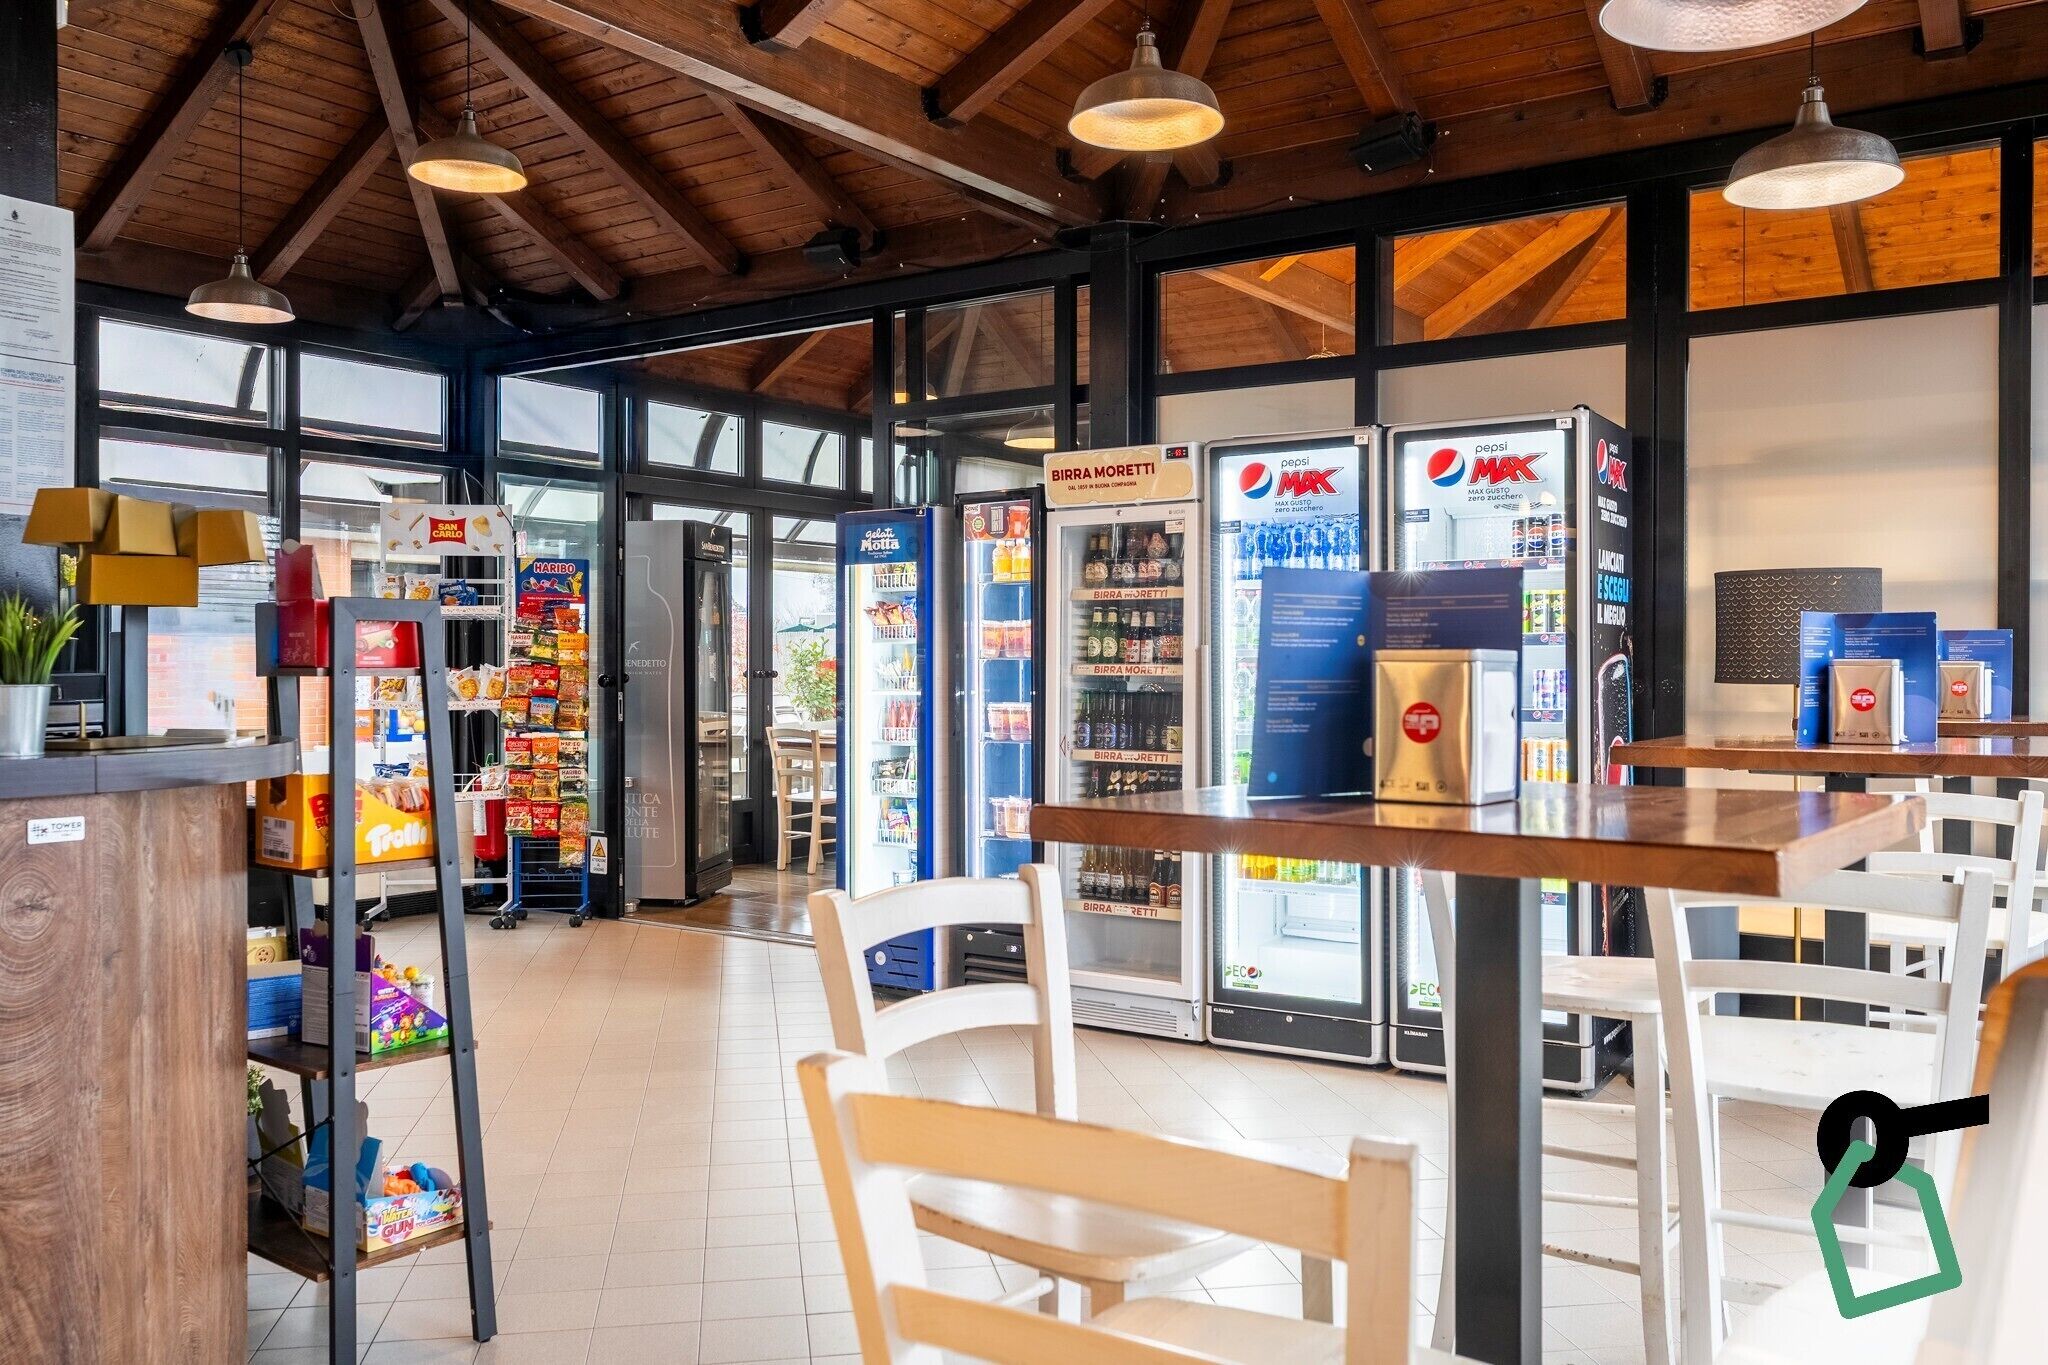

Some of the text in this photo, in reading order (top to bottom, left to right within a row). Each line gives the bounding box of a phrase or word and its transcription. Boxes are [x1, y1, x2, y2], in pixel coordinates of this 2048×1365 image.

[1475, 441, 1508, 455] pepsi
[1281, 456, 1310, 469] pepsi
[1051, 462, 1155, 482] BIRRA MORETTI
[1467, 452, 1548, 487] MAX
[1274, 466, 1345, 499] MAX
[1486, 492, 1524, 501] zucchero
[1291, 504, 1324, 513] zucchero
[437, 523, 458, 531] SAN
[432, 529, 464, 539] CARLO
[860, 536, 901, 552] Motta
[1598, 548, 1625, 574] LANCIATI
[534, 562, 576, 574] HARIBO
[1597, 573, 1630, 603] E SCEGLI
[1093, 591, 1122, 599] BIRRA
[1597, 603, 1626, 627] IL MEGLIO
[1093, 665, 1122, 674] BIRRA
[1094, 751, 1169, 763] BIRRA ORETTI
[625, 793, 662, 805] TICA
[625, 806, 659, 818] ONTE
[51, 821, 82, 830] TOWER
[365, 820, 428, 858] Trolli
[625, 827, 661, 839] LUTE
[1083, 902, 1113, 914] BIRRA
[381, 1217, 415, 1238] GUN
